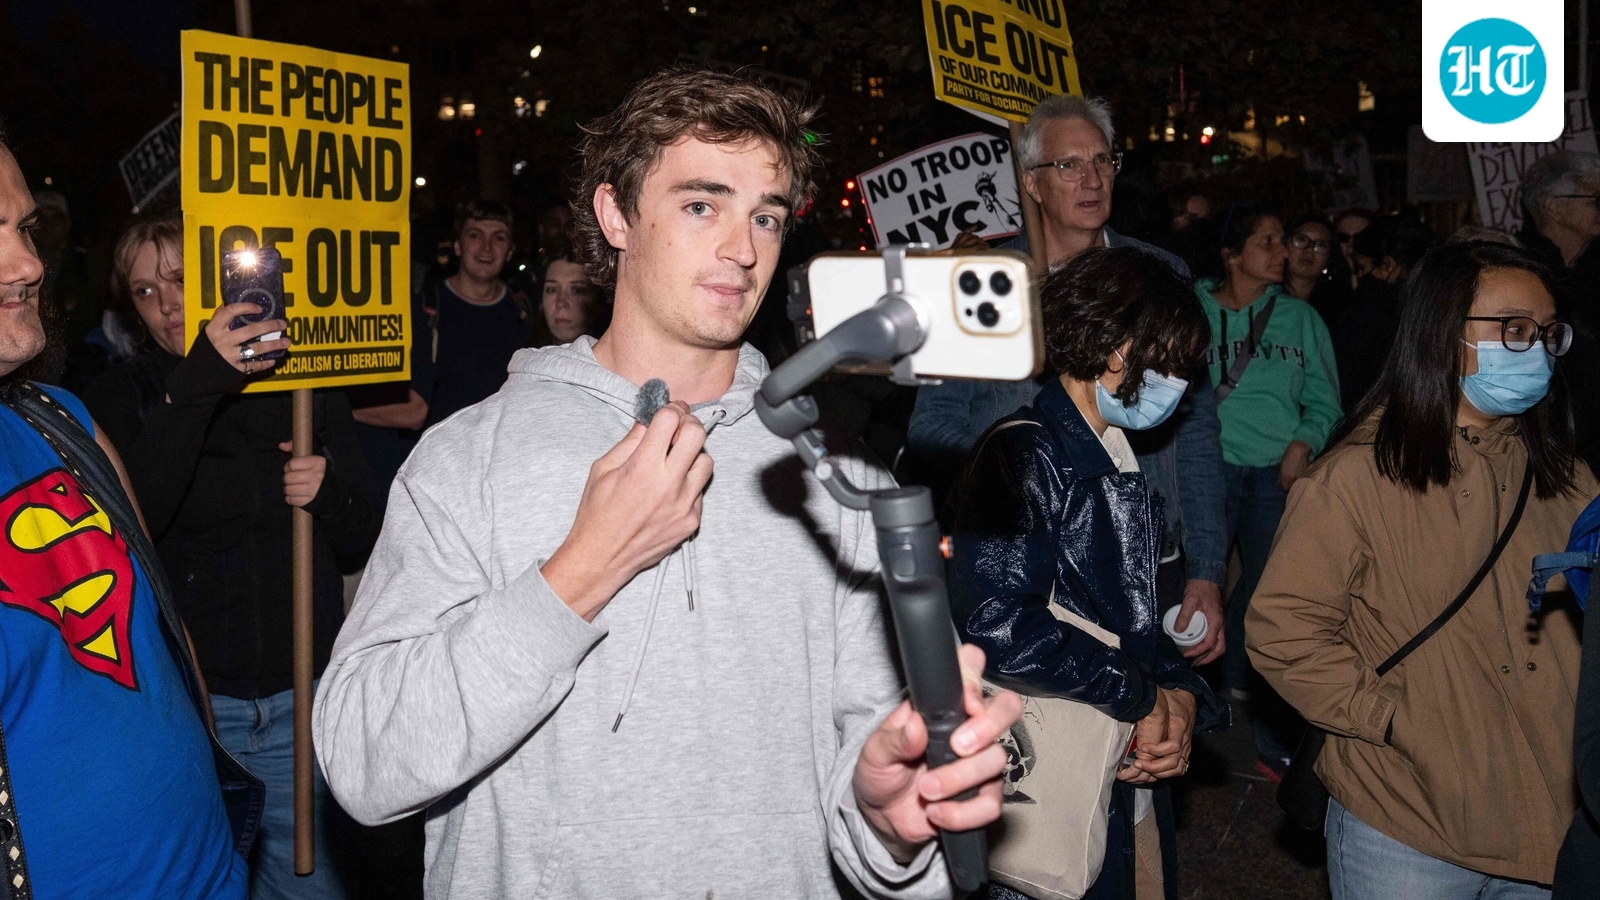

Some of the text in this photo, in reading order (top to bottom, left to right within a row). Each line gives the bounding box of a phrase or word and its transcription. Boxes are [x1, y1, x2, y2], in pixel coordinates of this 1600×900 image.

[932, 0, 1070, 94] ICE OUT
[194, 51, 404, 130] THE PEOPLE
[939, 55, 1052, 103] OF OUR COMMUN
[946, 80, 1034, 115] PARTY FOR SOCIALIS
[198, 120, 403, 203] DEMAND
[866, 138, 1010, 204] NO TROOP
[886, 200, 987, 245] NYC
[907, 183, 947, 216] IN
[306, 227, 400, 308] OUT
[333, 355, 342, 370] &
[343, 351, 401, 371] LIBERATION
